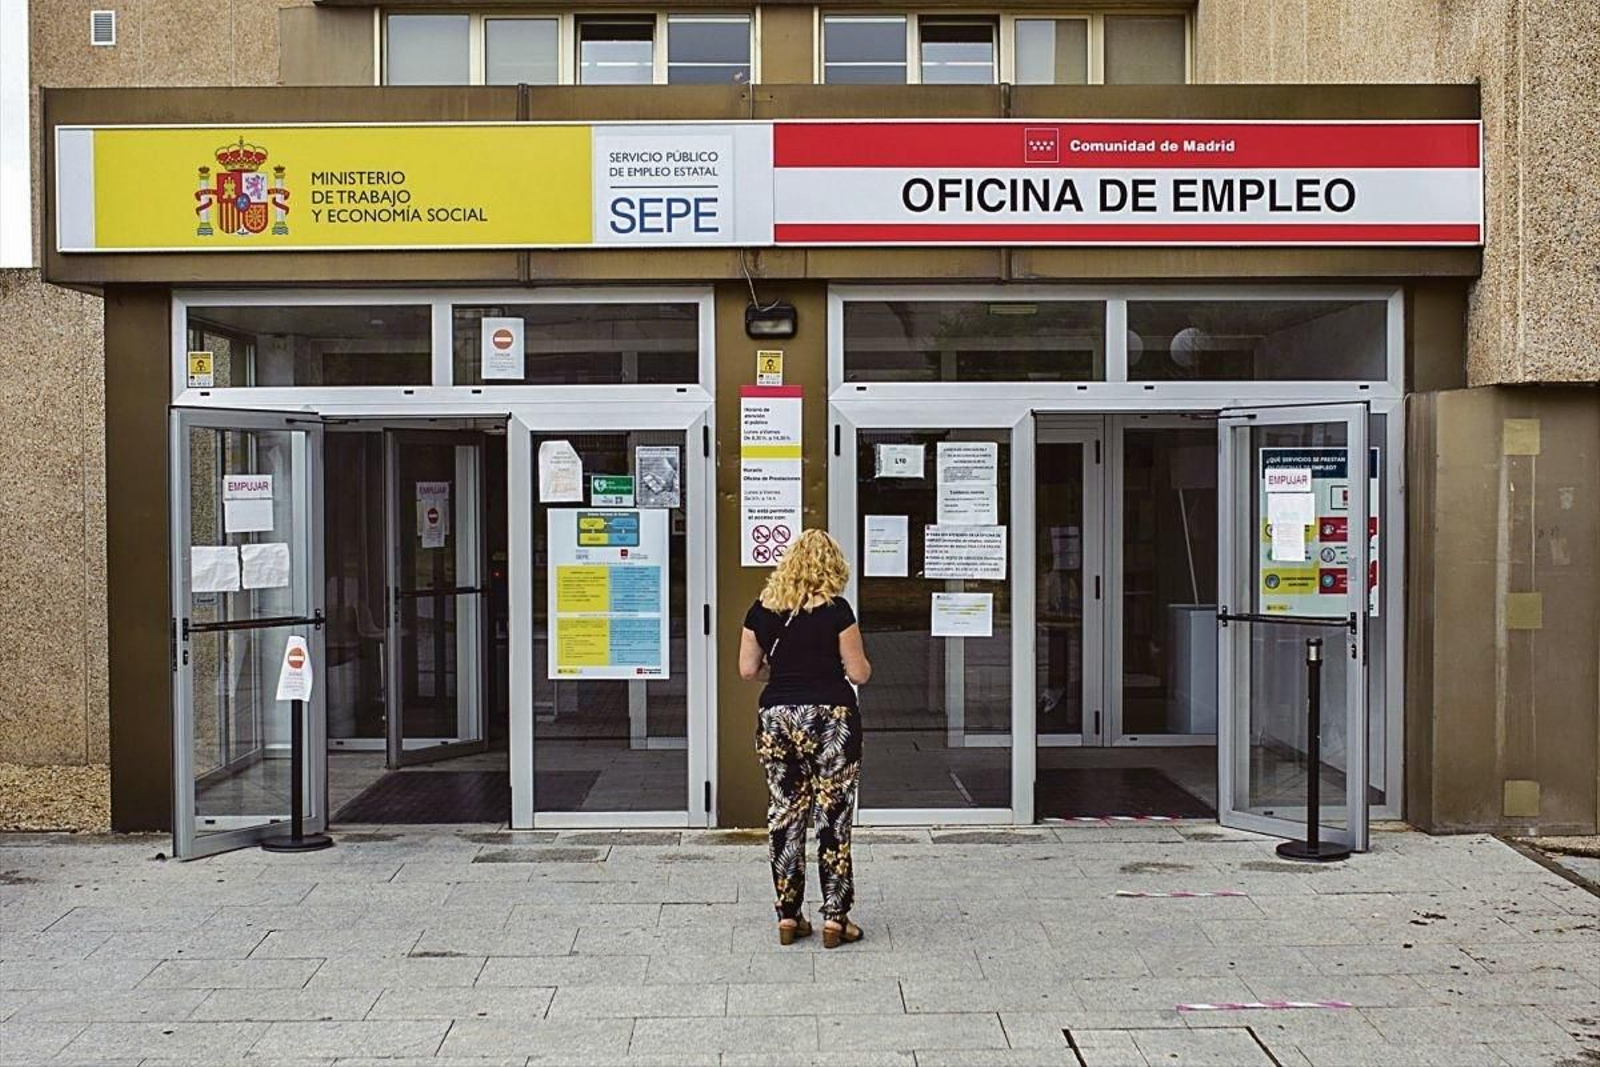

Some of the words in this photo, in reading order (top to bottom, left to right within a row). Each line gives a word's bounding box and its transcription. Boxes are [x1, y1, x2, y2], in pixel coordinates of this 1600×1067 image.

[1069, 139, 1156, 152] Comunidad
[1159, 139, 1179, 152] de
[1183, 139, 1235, 152] Madrid
[609, 152, 663, 163] SERVICIO
[666, 150, 719, 162] PÚBLICO
[311, 171, 406, 185] MINISTERIO
[609, 167, 625, 177] DE
[627, 167, 671, 177] EMPLEO
[674, 167, 719, 176] ESTATAL
[311, 190, 334, 204] DE
[336, 190, 412, 207] TRABAJO
[902, 177, 1084, 213] OFICINA
[1099, 178, 1157, 213] DE
[1172, 177, 1356, 213] EMPLEO
[311, 209, 322, 223] Y
[327, 205, 422, 223] ECONOMÍA
[427, 208, 488, 222] SOCIAL
[610, 196, 719, 234] SEPE
[228, 481, 269, 491] EMPUJAR
[1268, 475, 1308, 485] EMPUJAR
